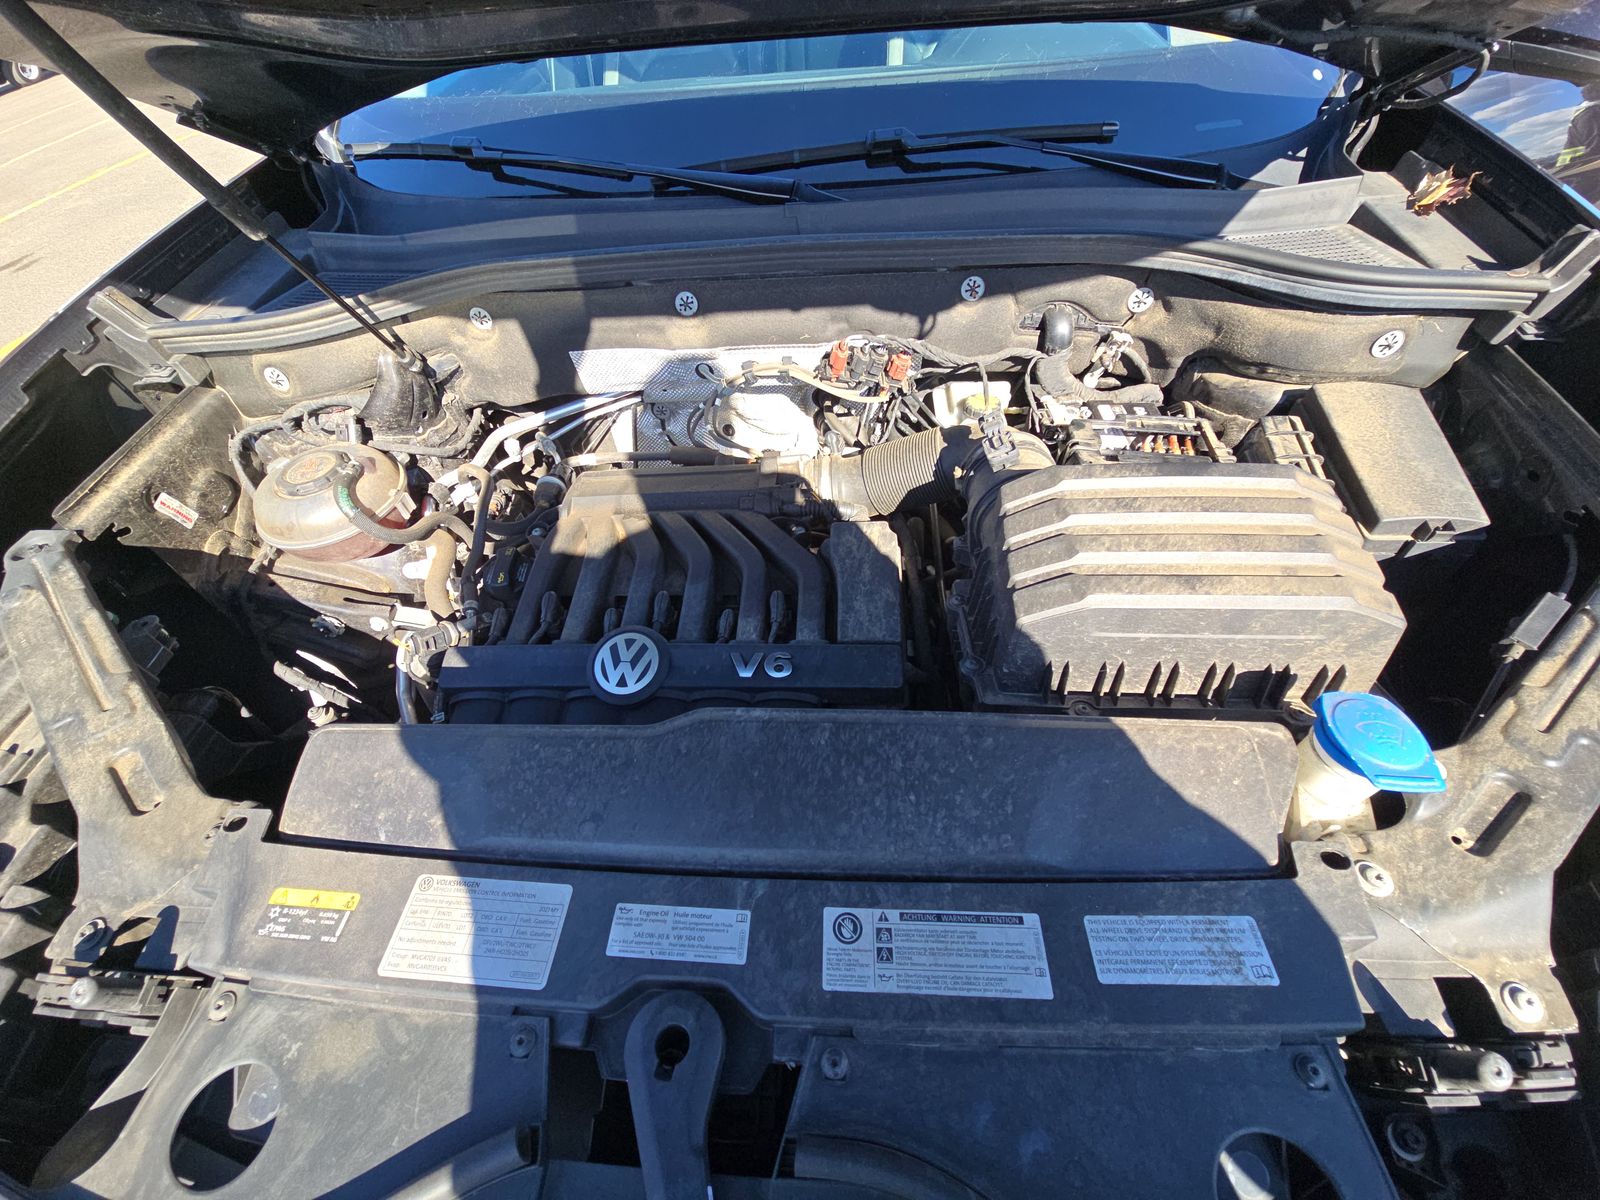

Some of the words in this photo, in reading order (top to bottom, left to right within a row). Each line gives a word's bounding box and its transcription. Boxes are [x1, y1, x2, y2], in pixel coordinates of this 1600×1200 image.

[730, 652, 793, 678] V6
[436, 880, 481, 888] VOLKSWAGEN
[501, 891, 536, 899] INFORMATION
[639, 909, 659, 918] Engine
[941, 914, 977, 922] WARNING
